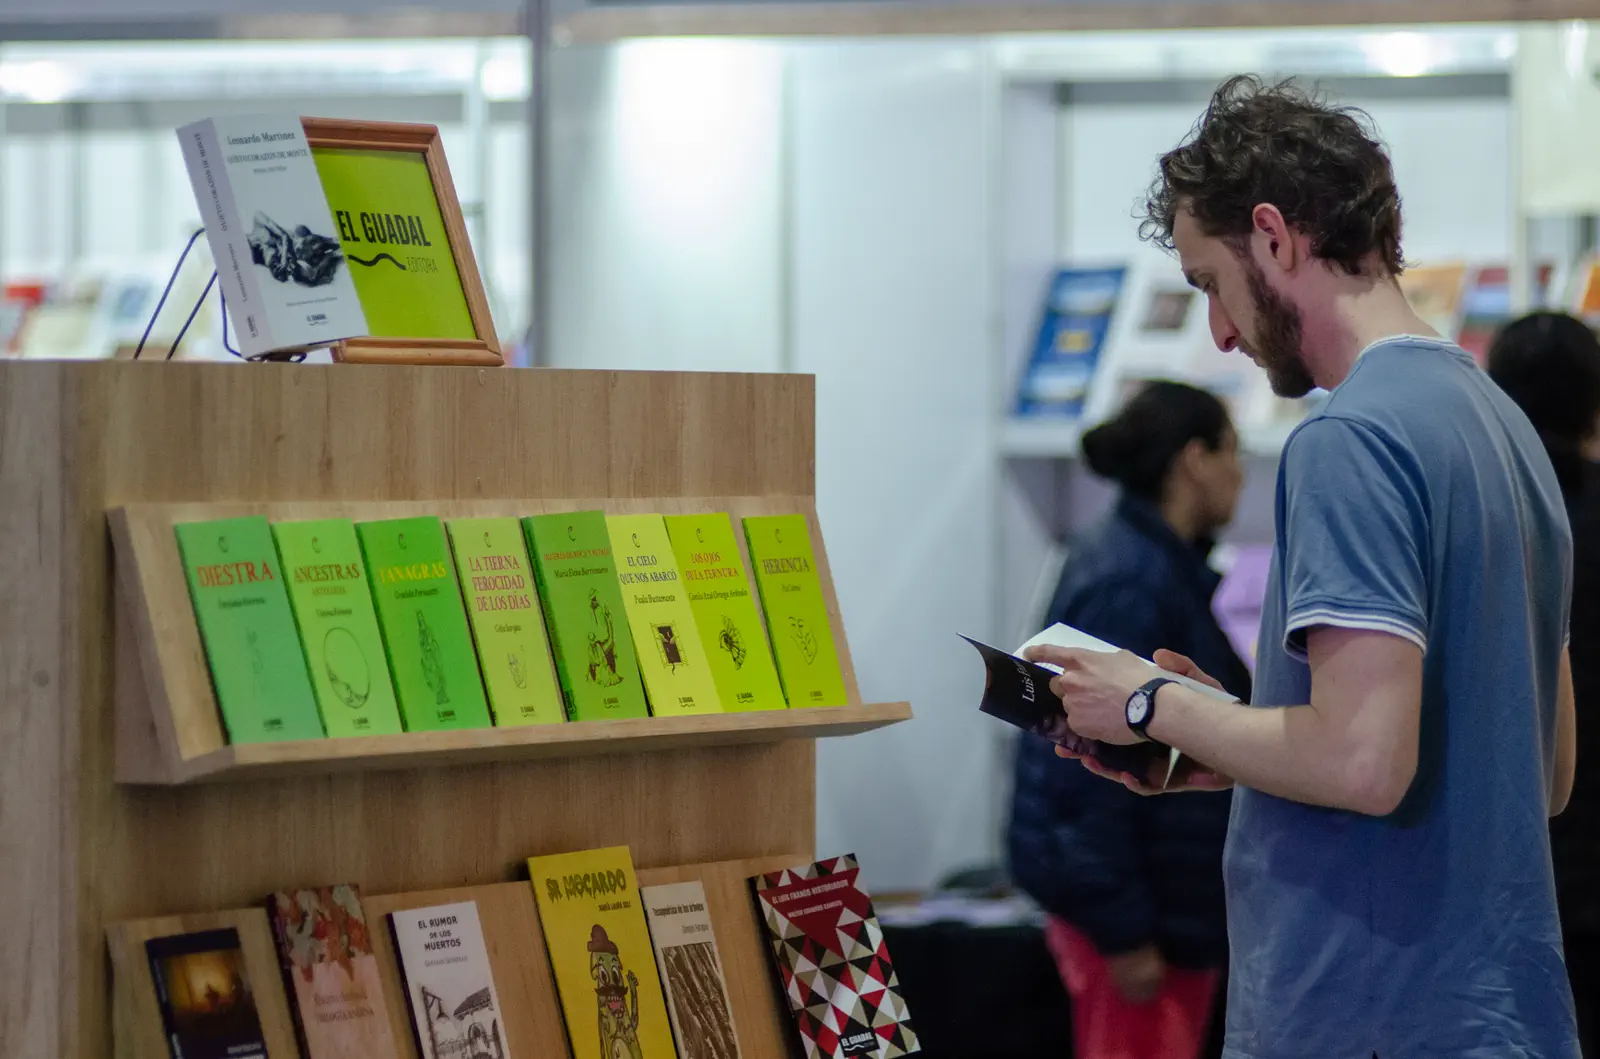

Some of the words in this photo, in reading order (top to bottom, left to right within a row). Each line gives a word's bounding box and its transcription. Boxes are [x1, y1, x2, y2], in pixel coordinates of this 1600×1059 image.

[227, 132, 261, 145] Leonardo
[336, 210, 360, 242] EL
[360, 211, 432, 247] GUADAL
[468, 556, 483, 572] LA
[482, 555, 520, 571] TIERNA
[626, 556, 637, 567] EL
[636, 555, 657, 567] CIELO
[762, 557, 810, 576] HERENCIA
[197, 558, 274, 587] DIESTRA
[294, 563, 360, 583] ANCESTRAS
[619, 572, 634, 586] QUE
[634, 572, 649, 584] NOS
[704, 567, 739, 580] TERNURA
[476, 596, 489, 612] DE
[489, 595, 508, 611] LOS
[508, 590, 531, 610] DÍAS
[1022, 677, 1035, 704] Luis
[417, 920, 427, 929] EL
[429, 915, 458, 928] RUMOR
[429, 931, 438, 939] DE
[439, 930, 452, 938] LOS
[424, 938, 462, 951] MUERTOS
[840, 1038, 850, 1047] EL
[848, 1031, 874, 1045] GUADAL
